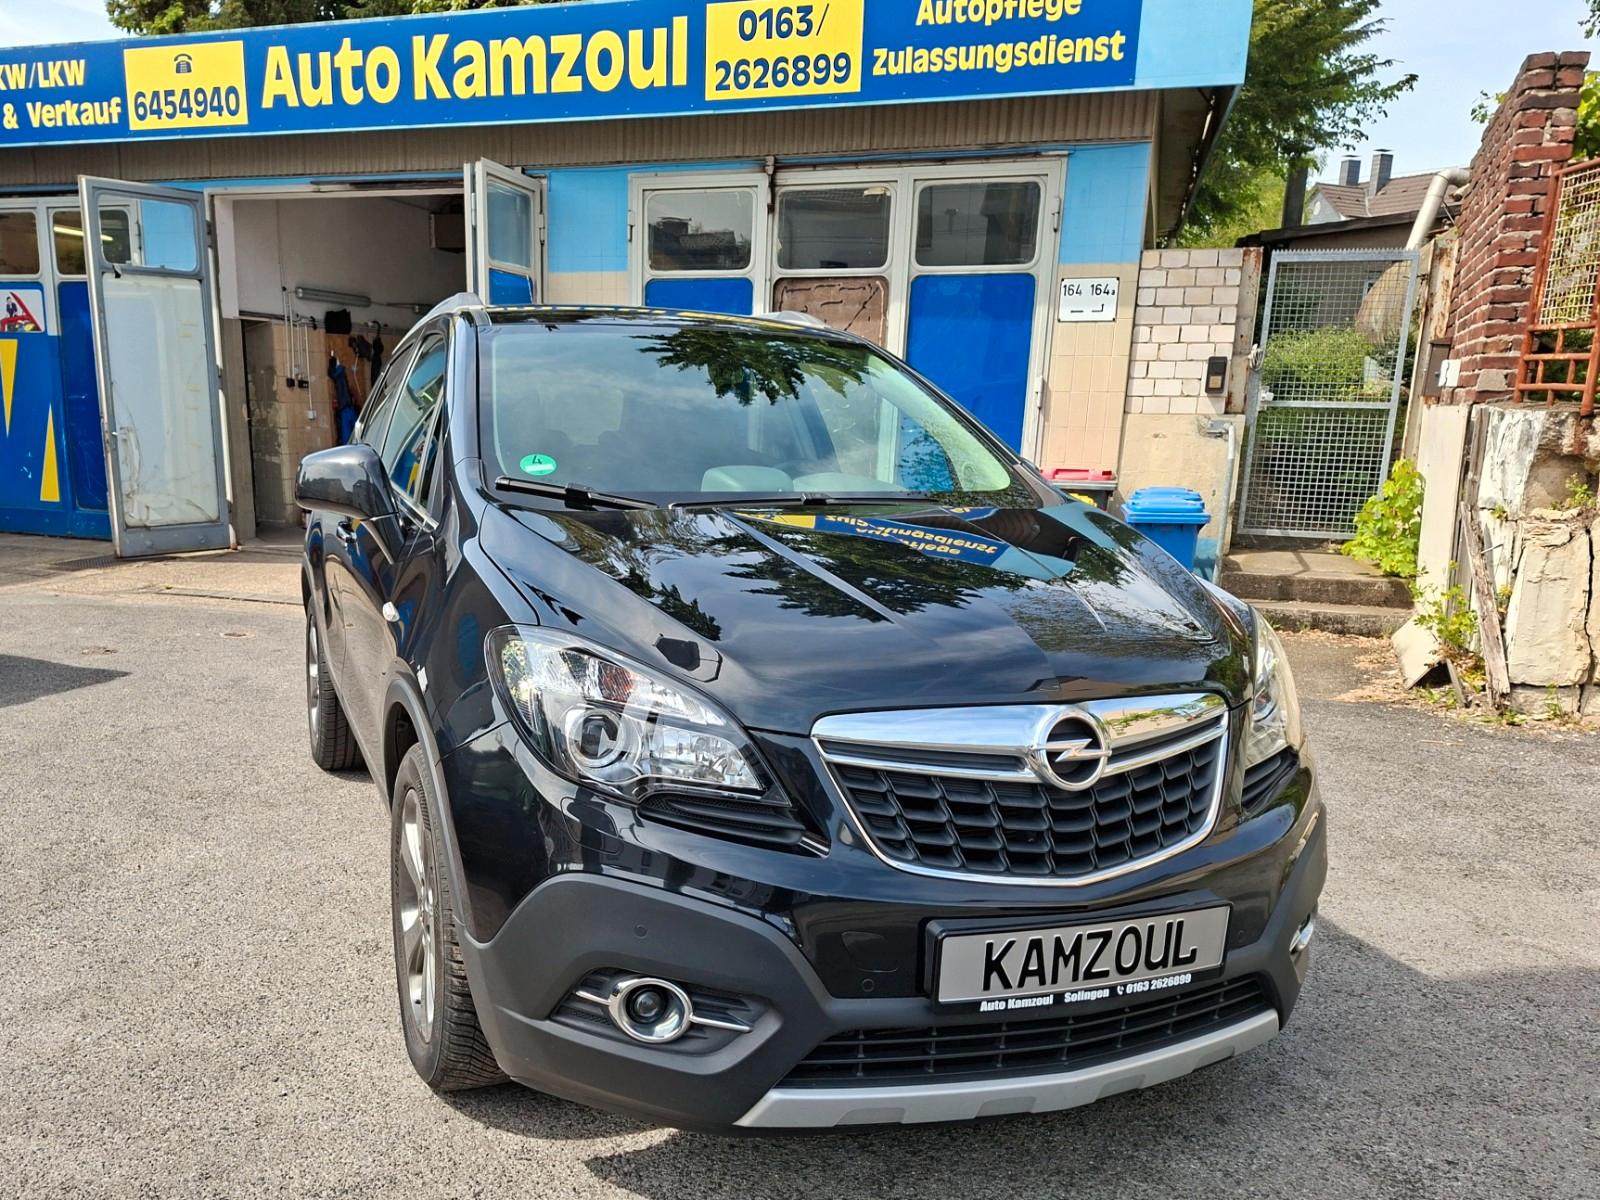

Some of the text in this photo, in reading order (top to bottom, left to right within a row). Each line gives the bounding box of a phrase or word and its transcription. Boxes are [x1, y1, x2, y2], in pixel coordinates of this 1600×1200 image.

[738, 3, 829, 41] 0163/
[915, 0, 1082, 26] Autopflege
[261, 16, 688, 108] Auto Kamzoul
[715, 52, 851, 91] 2626899
[872, 30, 1126, 76] Zulassungsdienst
[3, 97, 122, 129] & Verkauf
[134, 85, 240, 121] 6454940
[1063, 284, 1082, 296] 164
[982, 919, 1198, 991] KAMZOUL
[980, 973, 1192, 1012] Auto Kamzoul Solingen 0163 2626899
